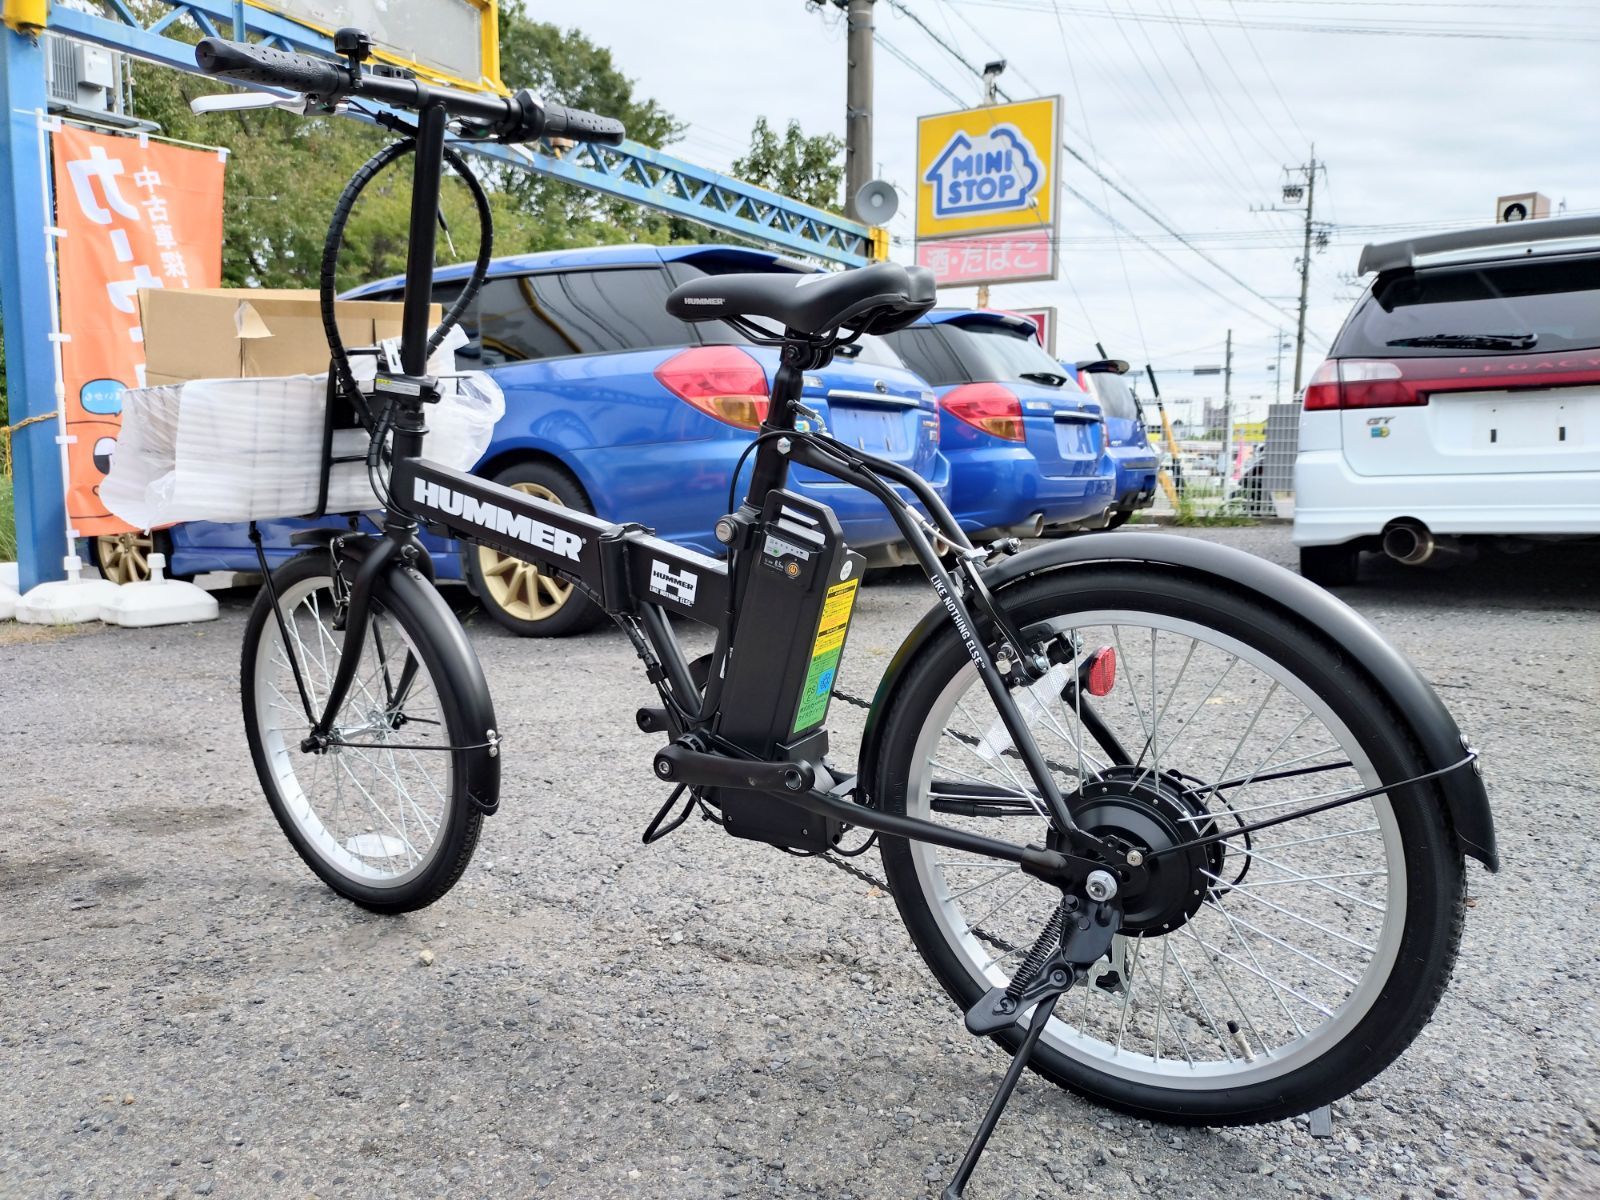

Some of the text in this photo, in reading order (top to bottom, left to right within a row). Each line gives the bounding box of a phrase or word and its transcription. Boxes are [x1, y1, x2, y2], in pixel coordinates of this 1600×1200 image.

[952, 149, 1013, 179] MINI
[947, 175, 1016, 204] STOP
[684, 297, 722, 305] HUMMER
[413, 476, 583, 562] HUMMER
[653, 570, 694, 590] HUMMER
[930, 574, 948, 597] LIKE
[943, 596, 970, 640] NOTHING
